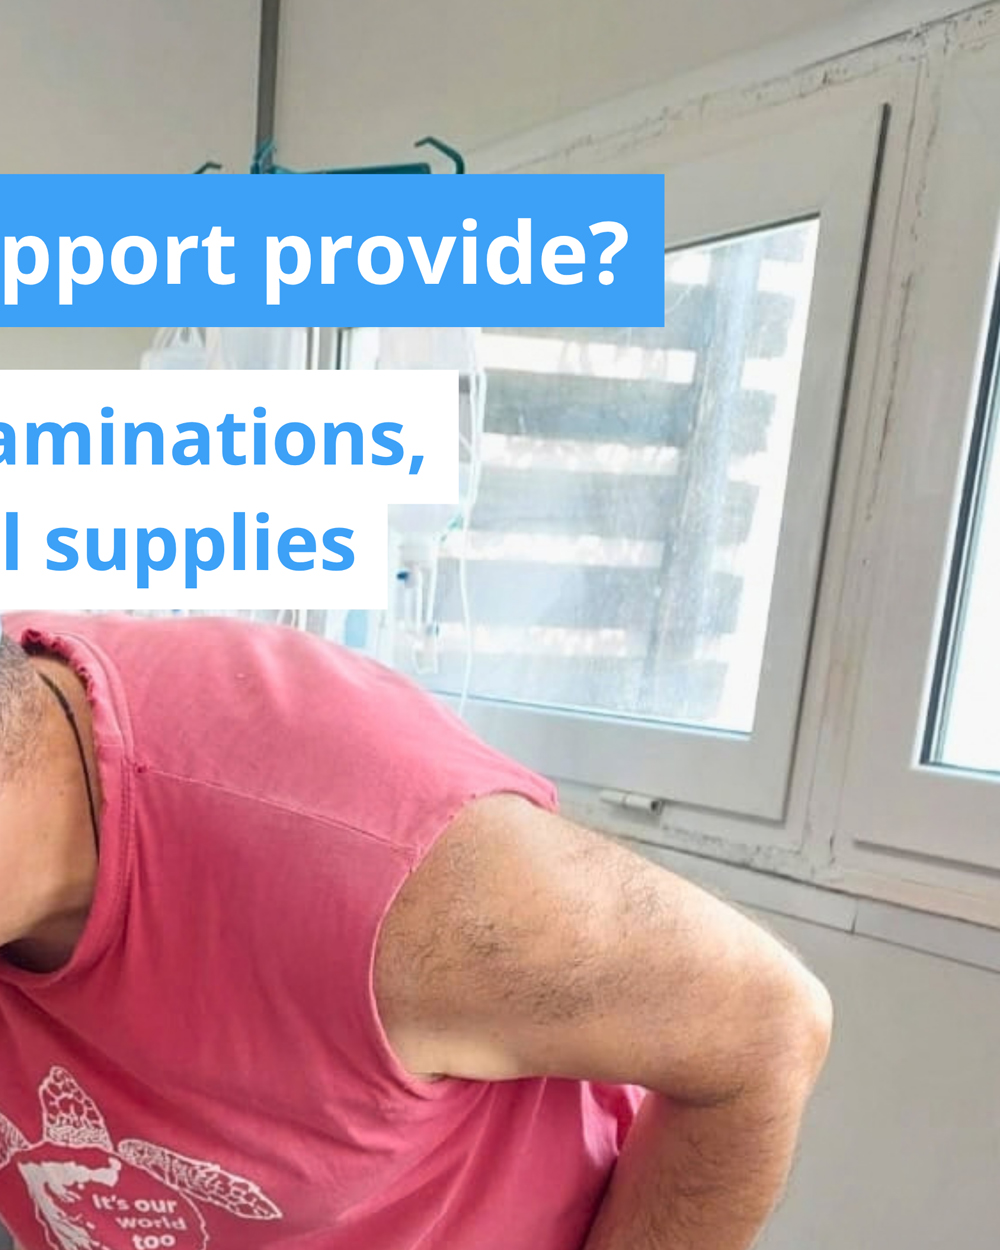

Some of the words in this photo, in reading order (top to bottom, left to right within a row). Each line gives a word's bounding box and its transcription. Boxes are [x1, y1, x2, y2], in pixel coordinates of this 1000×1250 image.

[91, 1194, 130, 1211] It's
[134, 1199, 177, 1214] our
[115, 1216, 188, 1231] world
